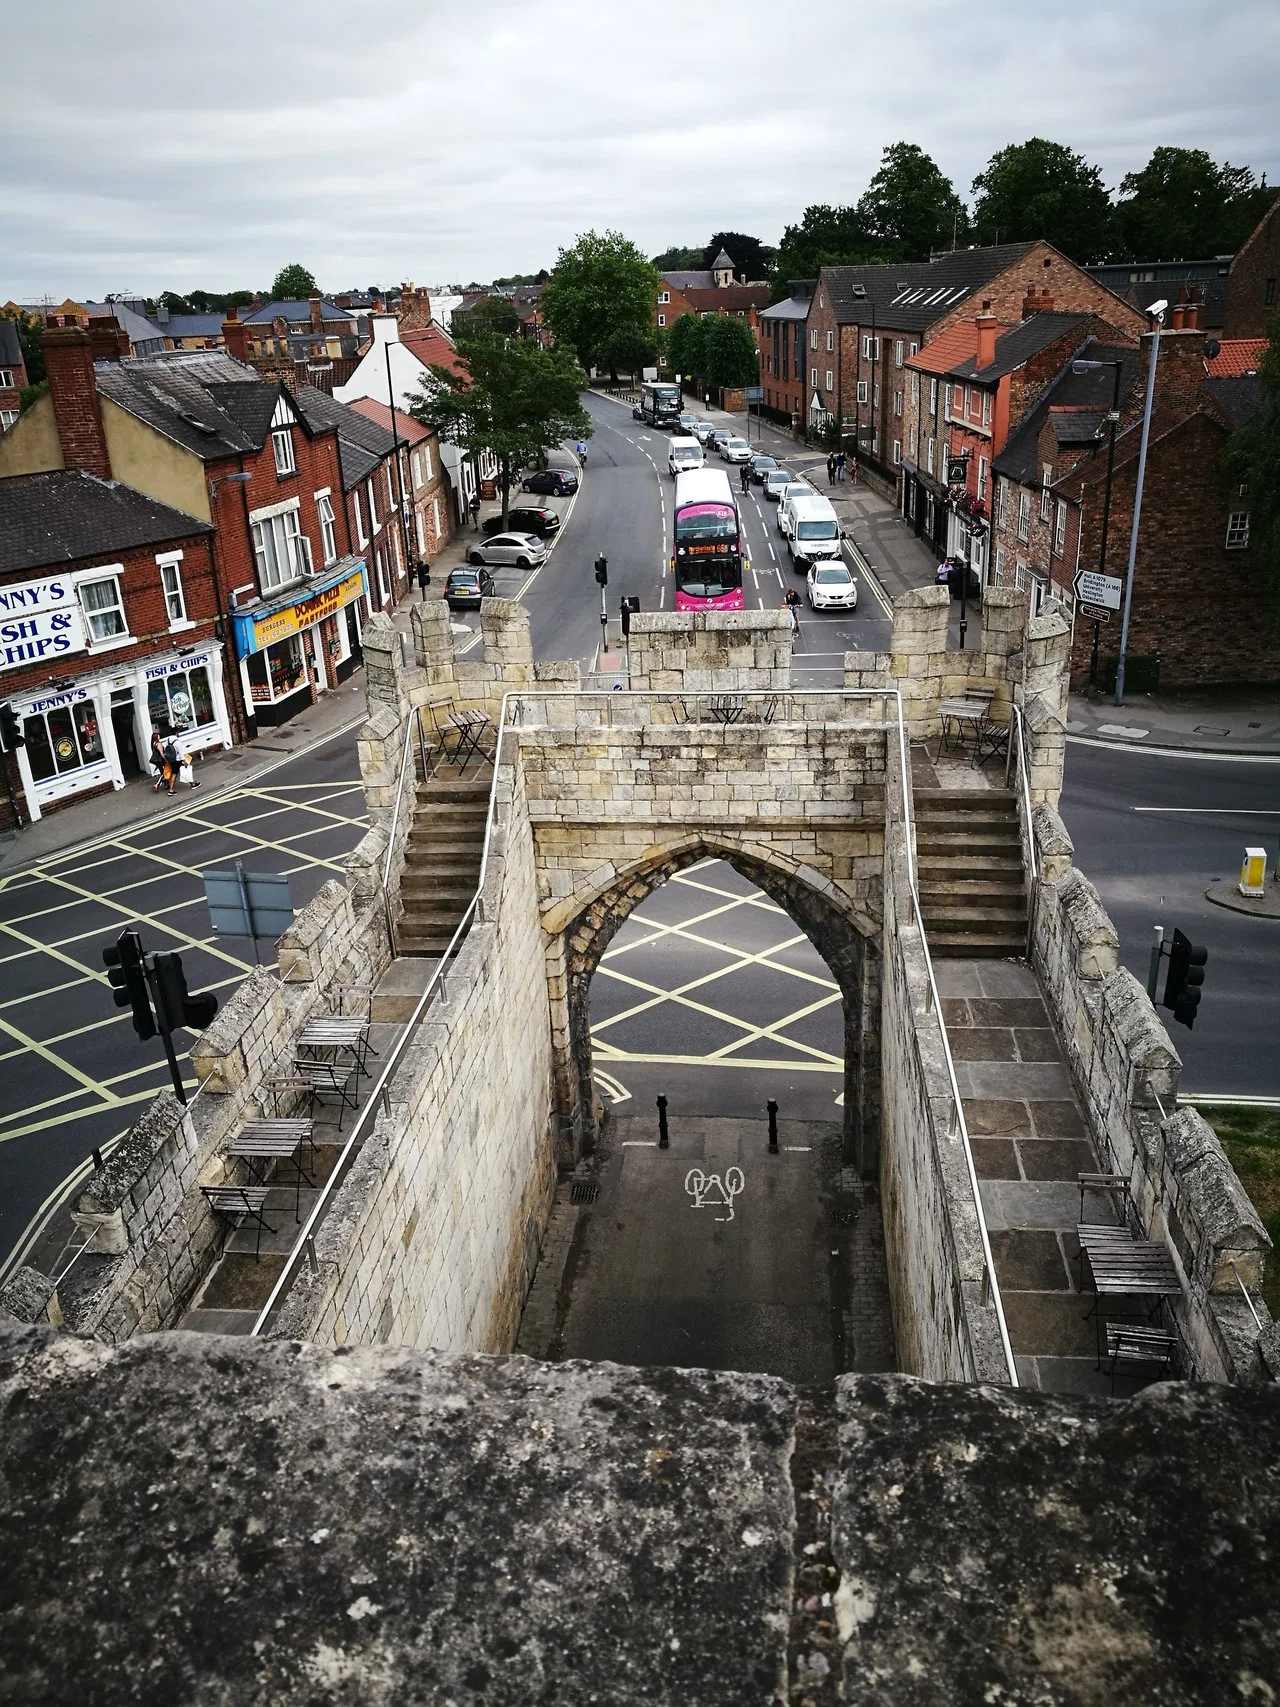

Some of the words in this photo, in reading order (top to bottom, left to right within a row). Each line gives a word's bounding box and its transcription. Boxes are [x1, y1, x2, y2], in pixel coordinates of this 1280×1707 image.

[0, 620, 39, 644] SH
[50, 613, 72, 631] &
[262, 619, 286, 634] BURGERS
[145, 666, 168, 680] FISH
[169, 663, 178, 672] &
[180, 654, 209, 669] CHIPS
[29, 688, 88, 714] JENNY'S
